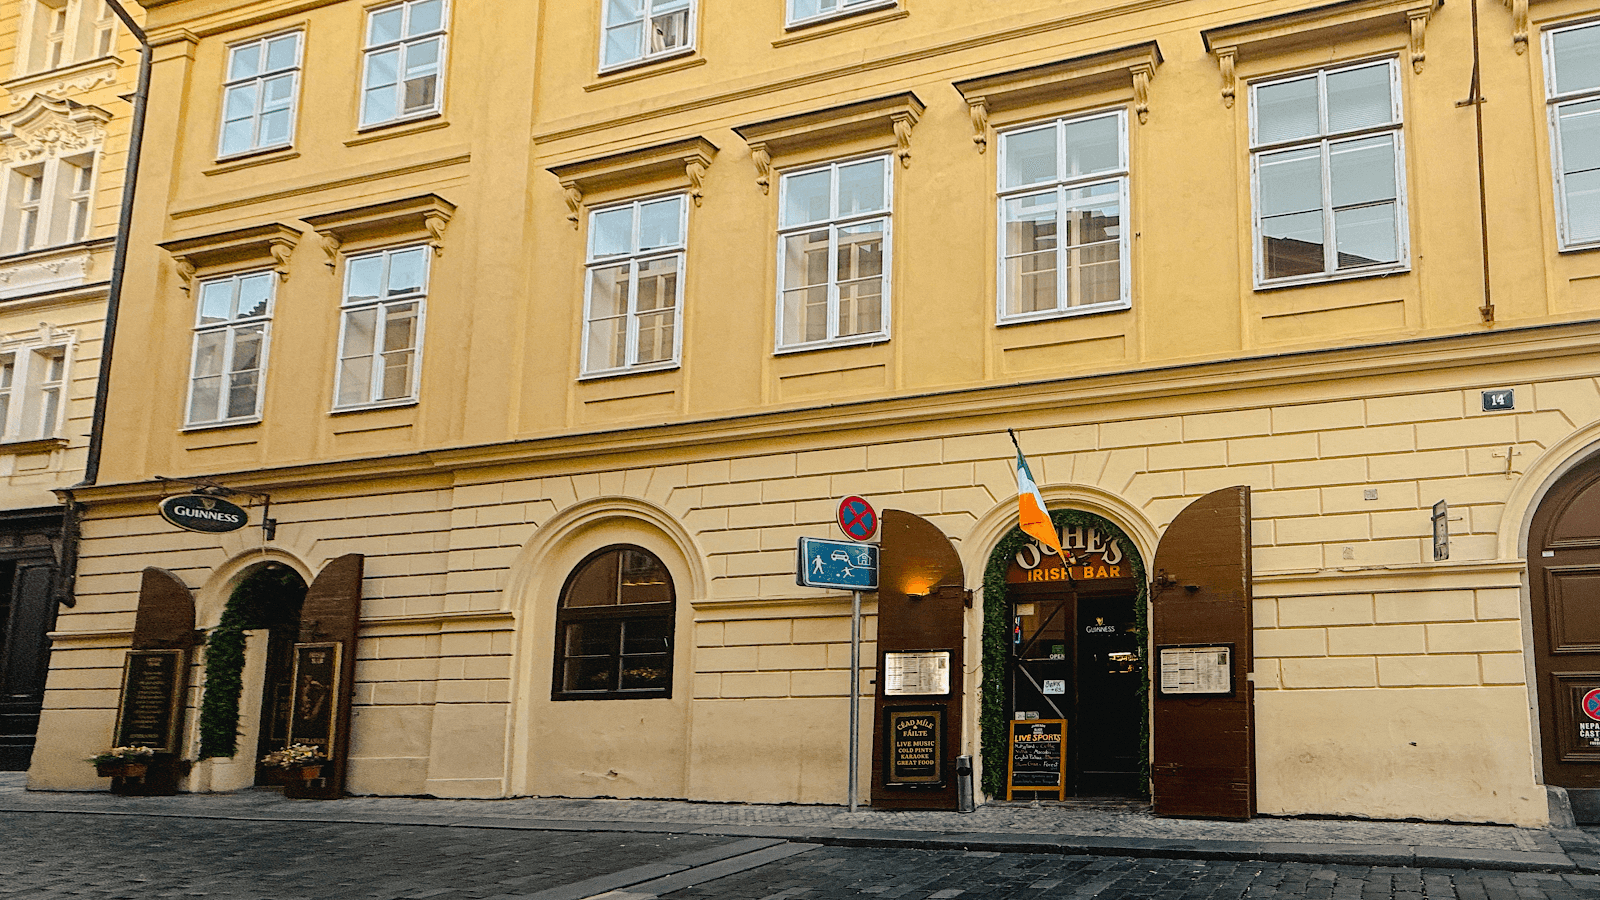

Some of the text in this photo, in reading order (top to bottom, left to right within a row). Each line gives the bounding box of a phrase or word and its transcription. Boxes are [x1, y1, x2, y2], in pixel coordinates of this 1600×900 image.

[1491, 394, 1504, 405] 14
[173, 505, 239, 523] GUINNESS
[1027, 565, 1121, 582] IRISH BAR
[1085, 625, 1116, 633] GUINNESS
[897, 719, 934, 730] CÉAD MÍLE
[1014, 733, 1061, 743] LIVE SPORTS
[1043, 760, 1059, 768] Forest
